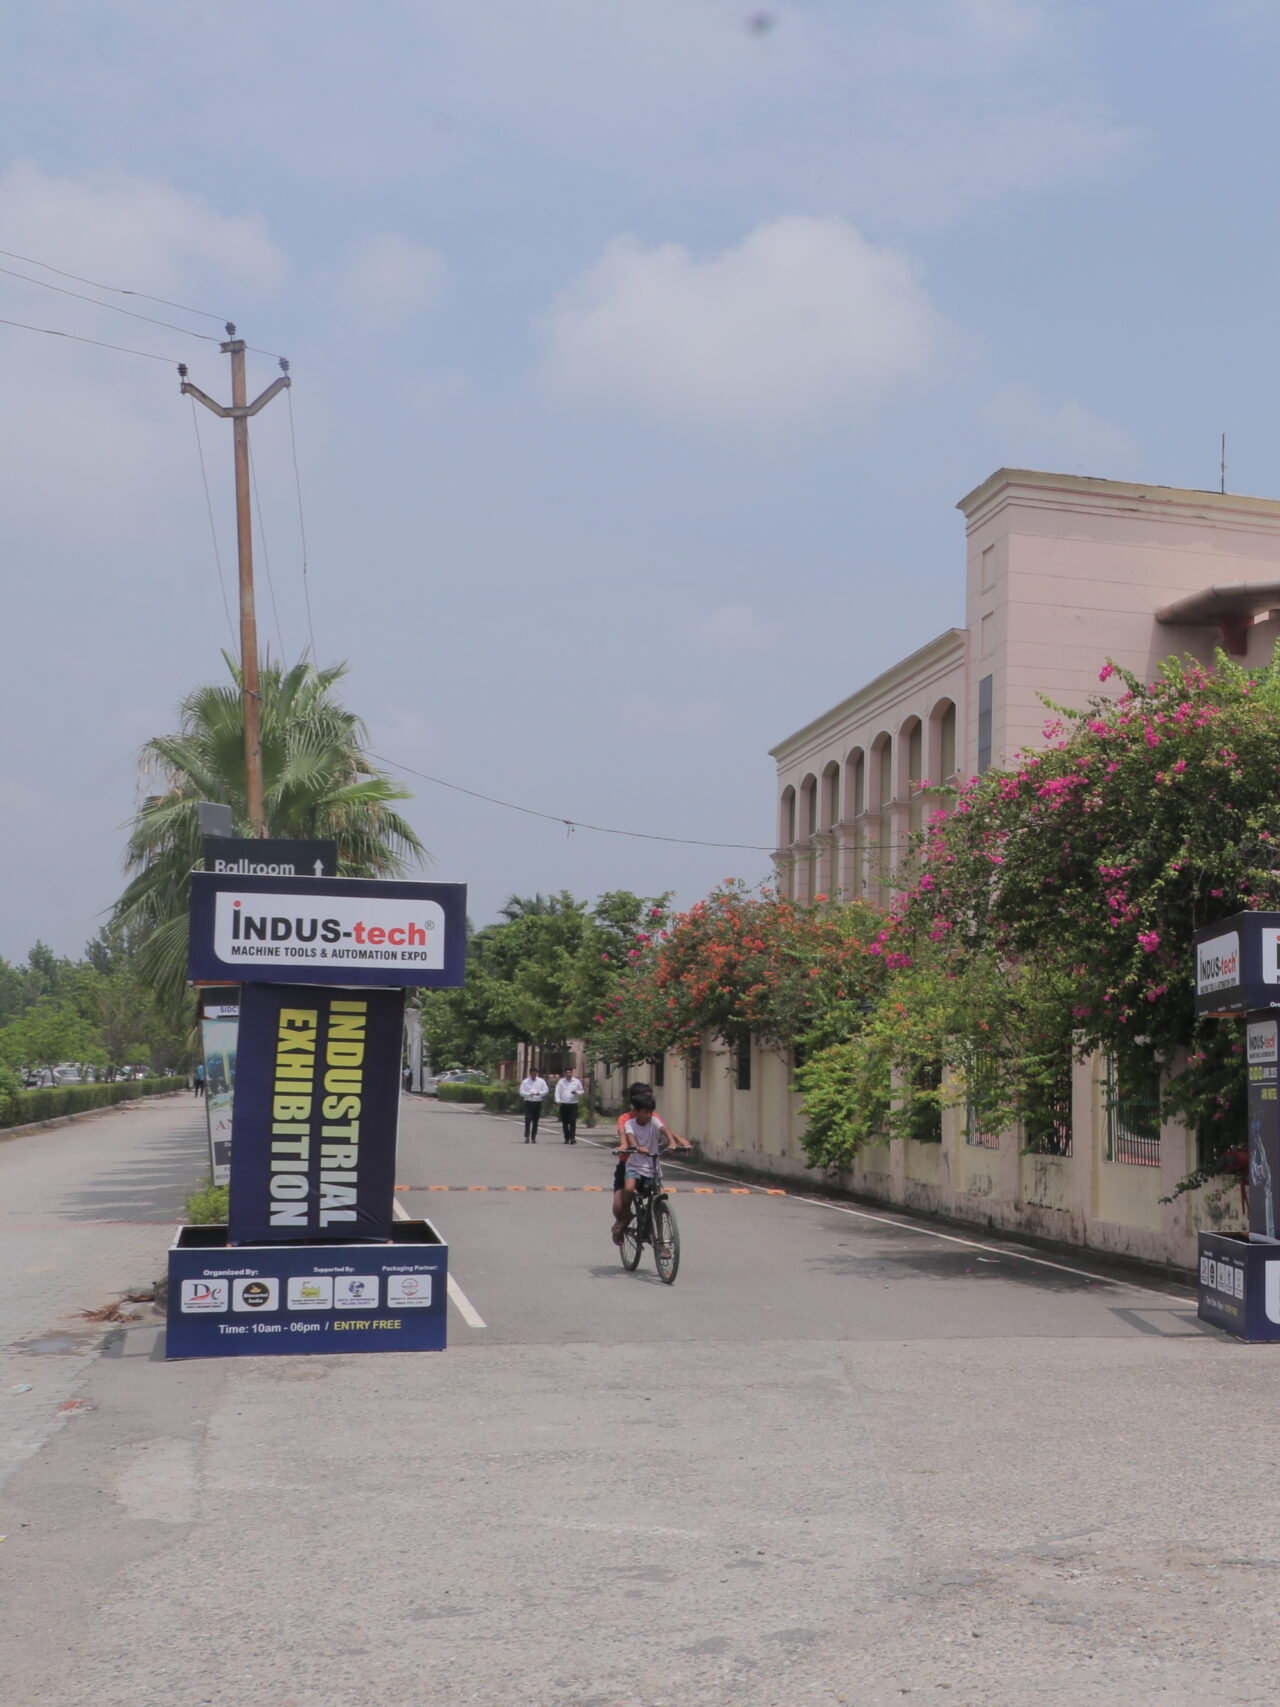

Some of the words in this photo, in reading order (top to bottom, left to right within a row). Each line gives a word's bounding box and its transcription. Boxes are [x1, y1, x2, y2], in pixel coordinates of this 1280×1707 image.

[215, 858, 296, 876] Ballroom
[231, 946, 280, 957] MACHINE
[284, 947, 317, 958] TOOLS
[320, 948, 328, 958] &
[331, 949, 398, 960] AUTOMATION
[401, 951, 427, 961] EXPO
[269, 1008, 318, 1226] EXHIBITION
[319, 1000, 368, 1228] INDUSTRIAL
[203, 1269, 245, 1277] Organized
[218, 1324, 249, 1334] Time:
[251, 1323, 282, 1333] 10am
[290, 1322, 320, 1334] 06pm
[333, 1320, 370, 1331] ENTRY
[372, 1319, 402, 1330] FREE
